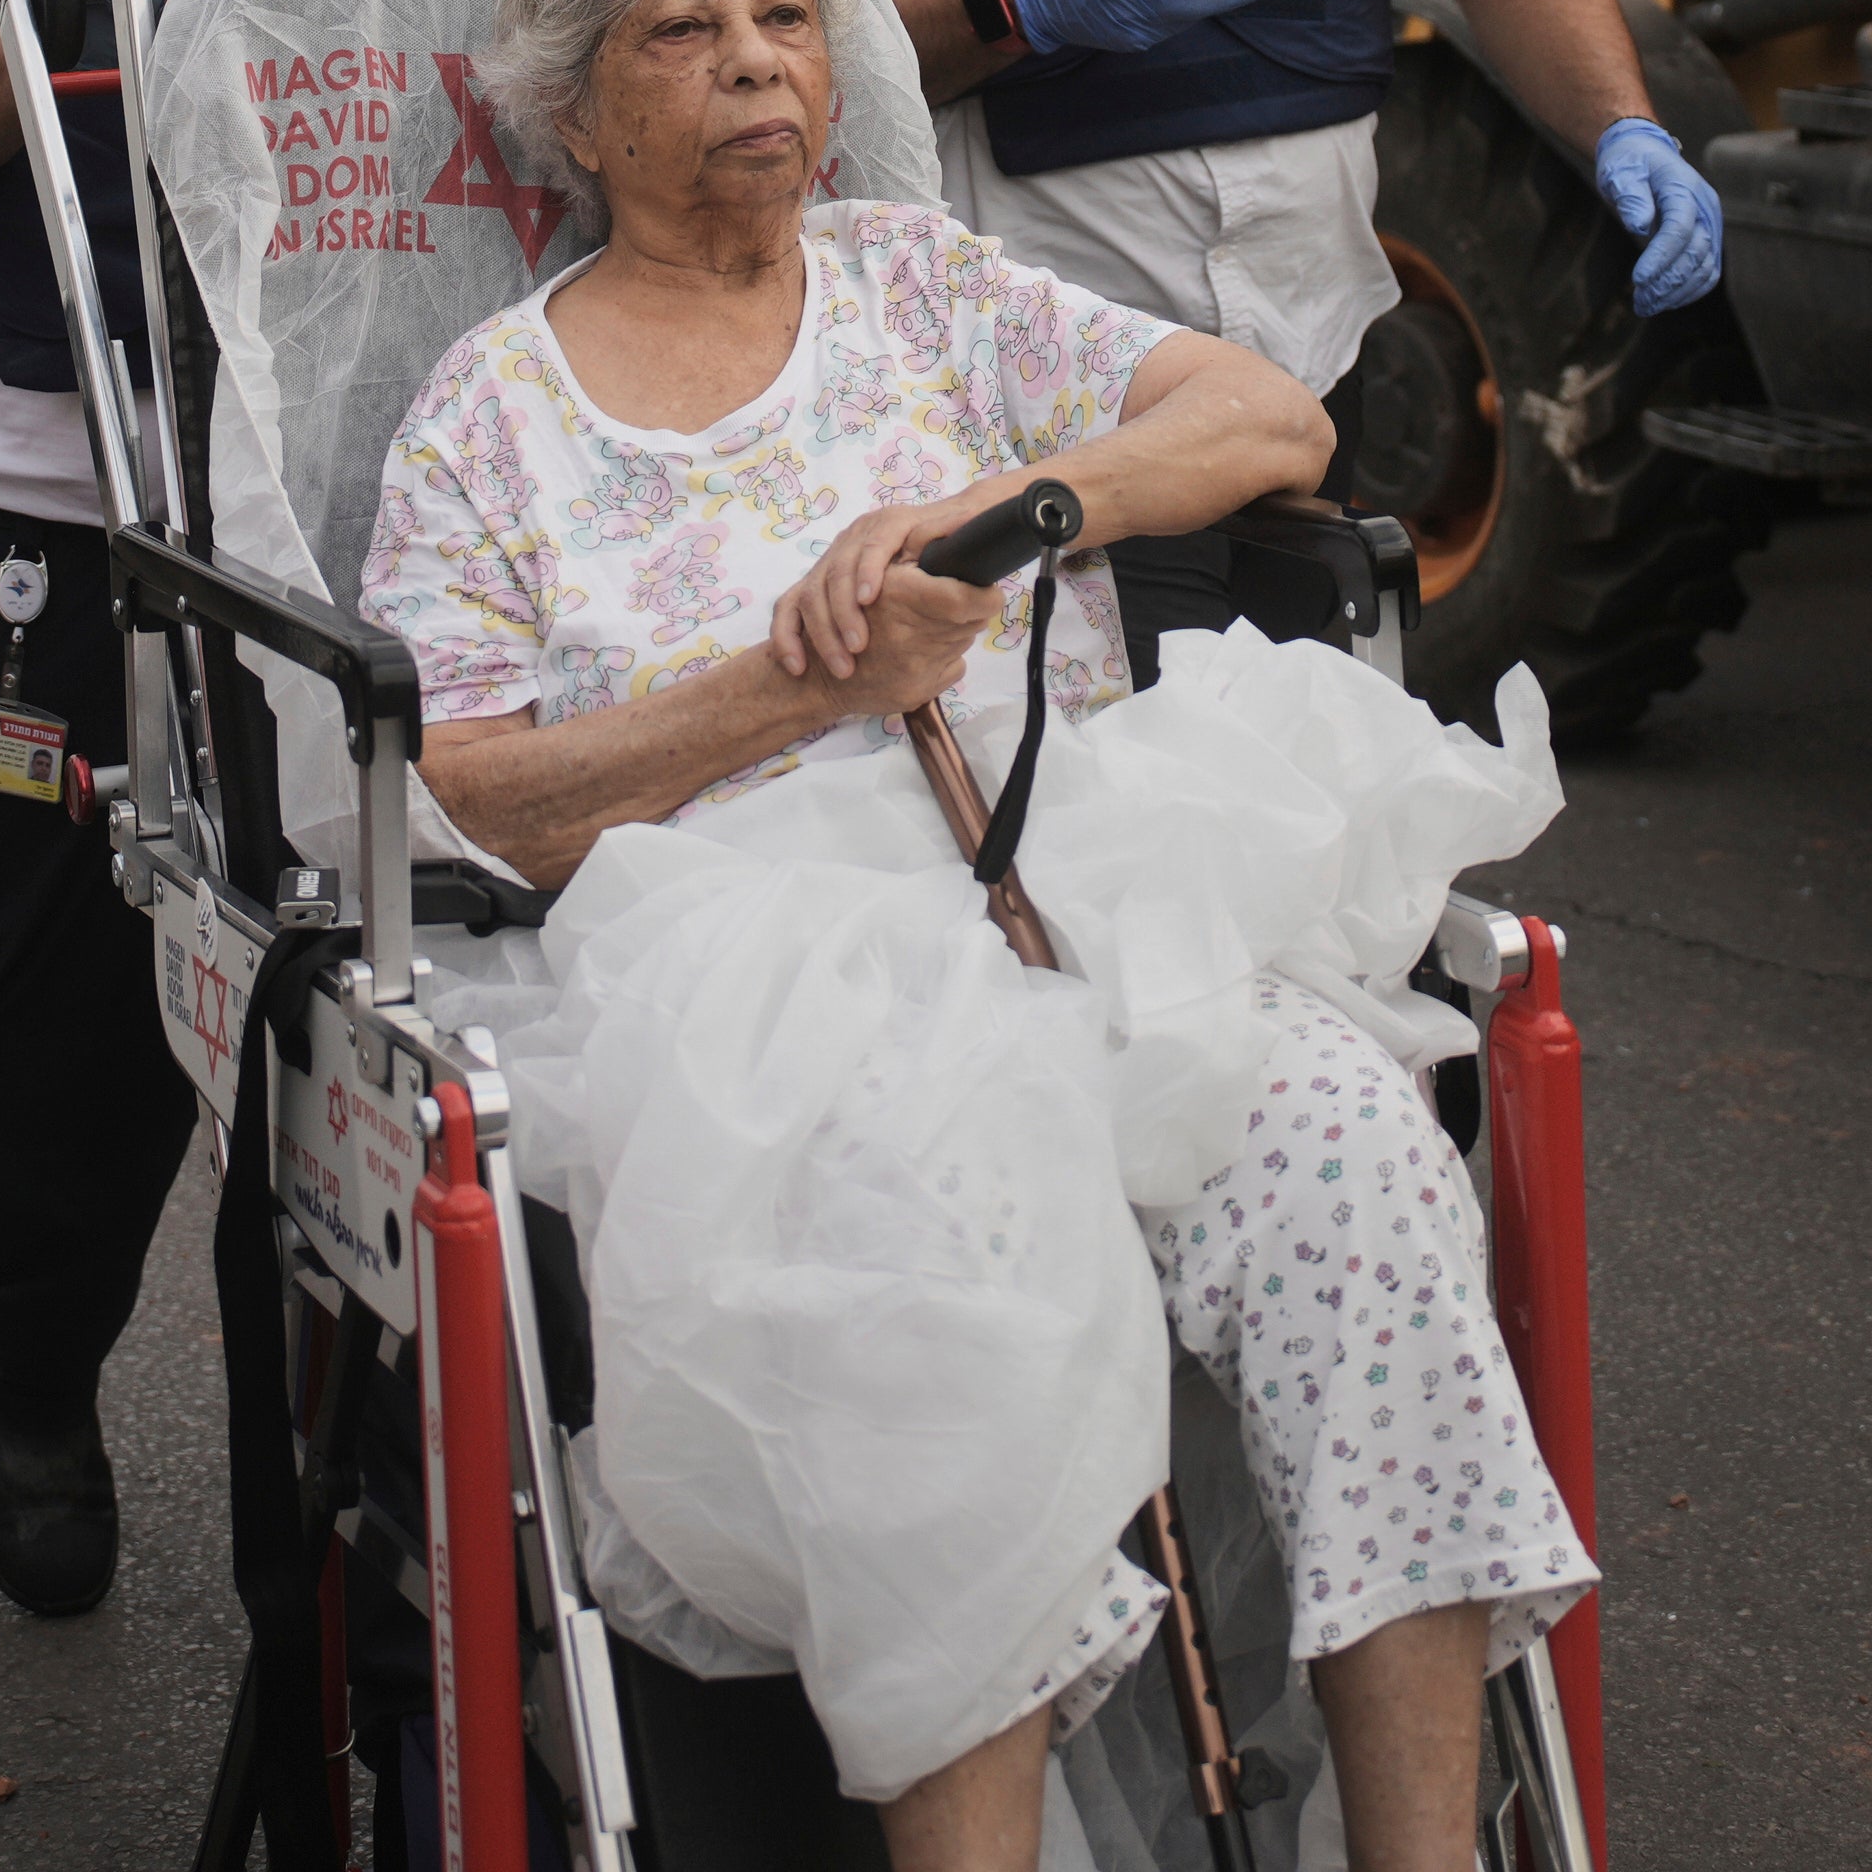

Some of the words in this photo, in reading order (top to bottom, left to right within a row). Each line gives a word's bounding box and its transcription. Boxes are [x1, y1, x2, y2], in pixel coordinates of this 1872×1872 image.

[244, 47, 407, 104] MAGEN
[281, 155, 390, 207] DOM
[4, 722, 32, 737] מתנדב
[32, 729, 60, 743] תעודת
[296, 871, 320, 899] FERNO
[165, 934, 186, 965] MAGEN
[166, 954, 184, 982] DAVID
[167, 975, 185, 1003] ADOM
[167, 993, 174, 1014] IN
[174, 1000, 193, 1030] ISRAEL
[302, 1148, 320, 1182] דוד
[323, 1166, 341, 1199] מגן
[436, 1543, 452, 1616] מגן
[440, 1630, 453, 1701] דוד
